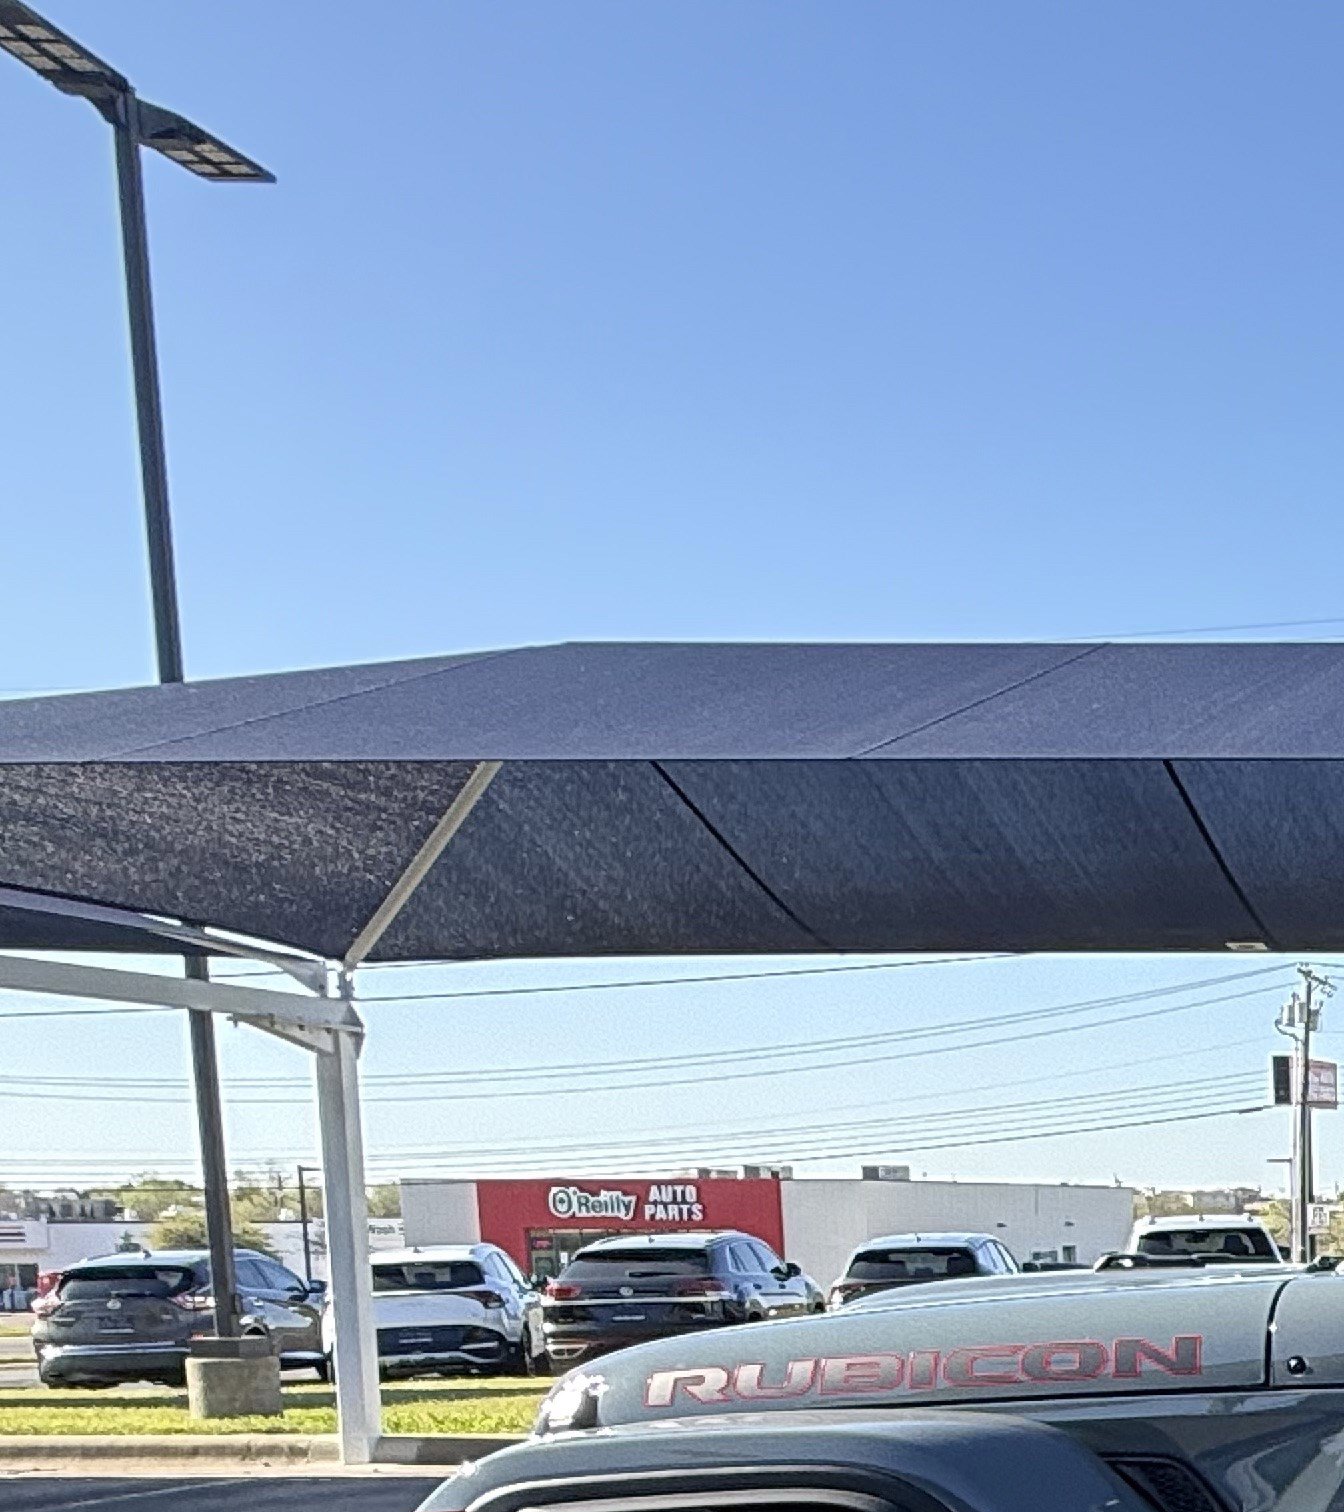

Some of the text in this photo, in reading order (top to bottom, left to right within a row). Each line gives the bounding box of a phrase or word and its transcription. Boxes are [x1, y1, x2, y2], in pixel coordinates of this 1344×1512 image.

[550, 1187, 636, 1219] O'Reilly
[649, 1184, 698, 1203] AUTO
[644, 1204, 704, 1222] PARTS
[644, 1334, 1204, 1408] RUBICON
